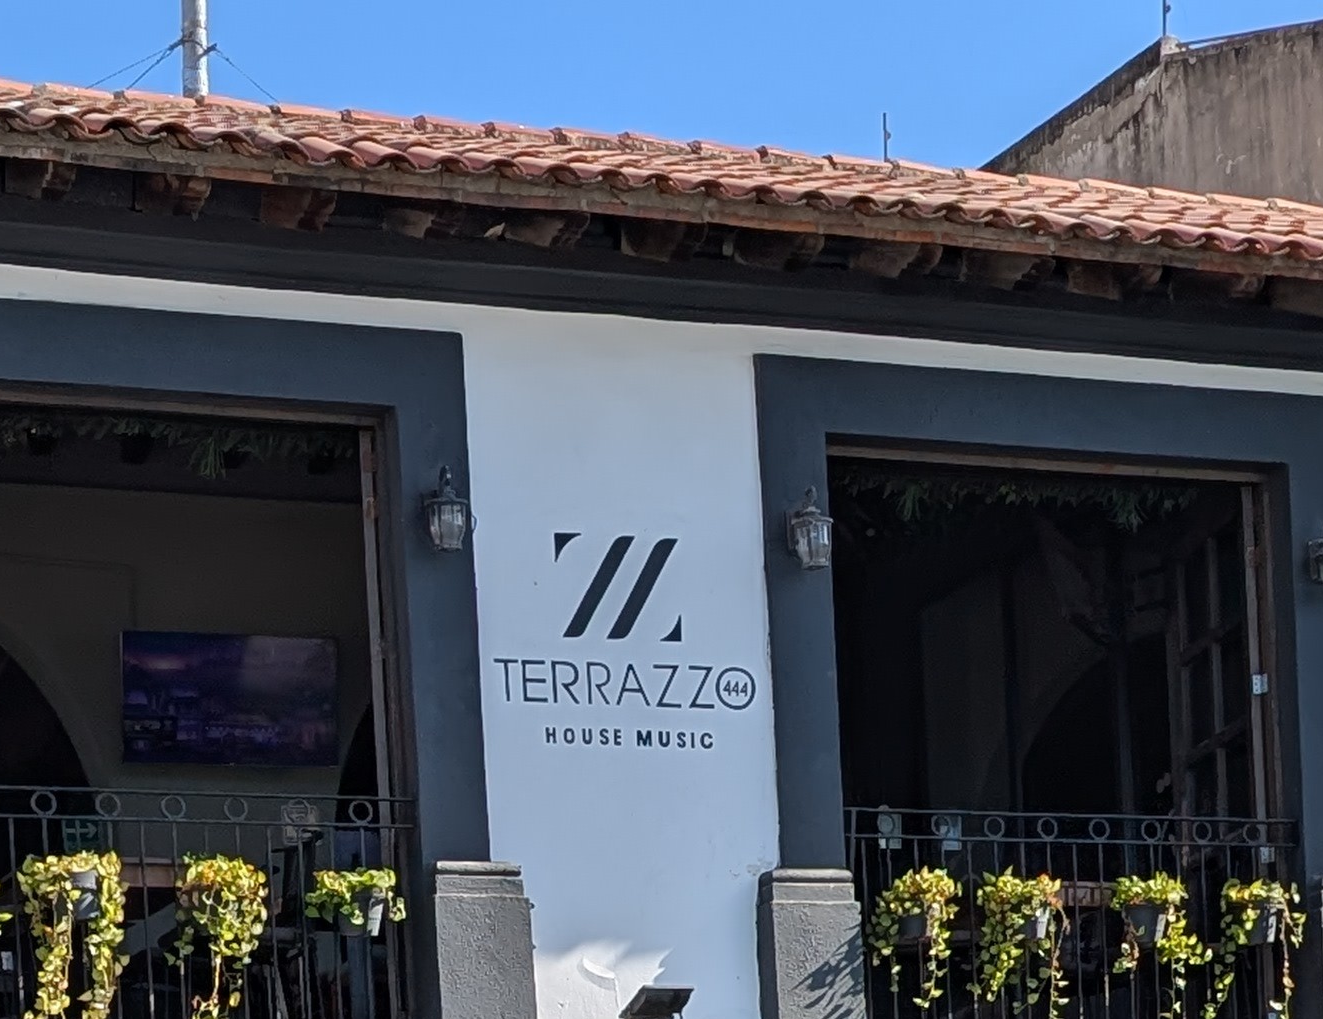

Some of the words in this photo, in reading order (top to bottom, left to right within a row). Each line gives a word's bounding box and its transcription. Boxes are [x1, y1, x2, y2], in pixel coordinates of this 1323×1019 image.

[723, 679, 749, 698] 444
[544, 726, 623, 747] HOUSE
[635, 729, 715, 750] MUSIC
